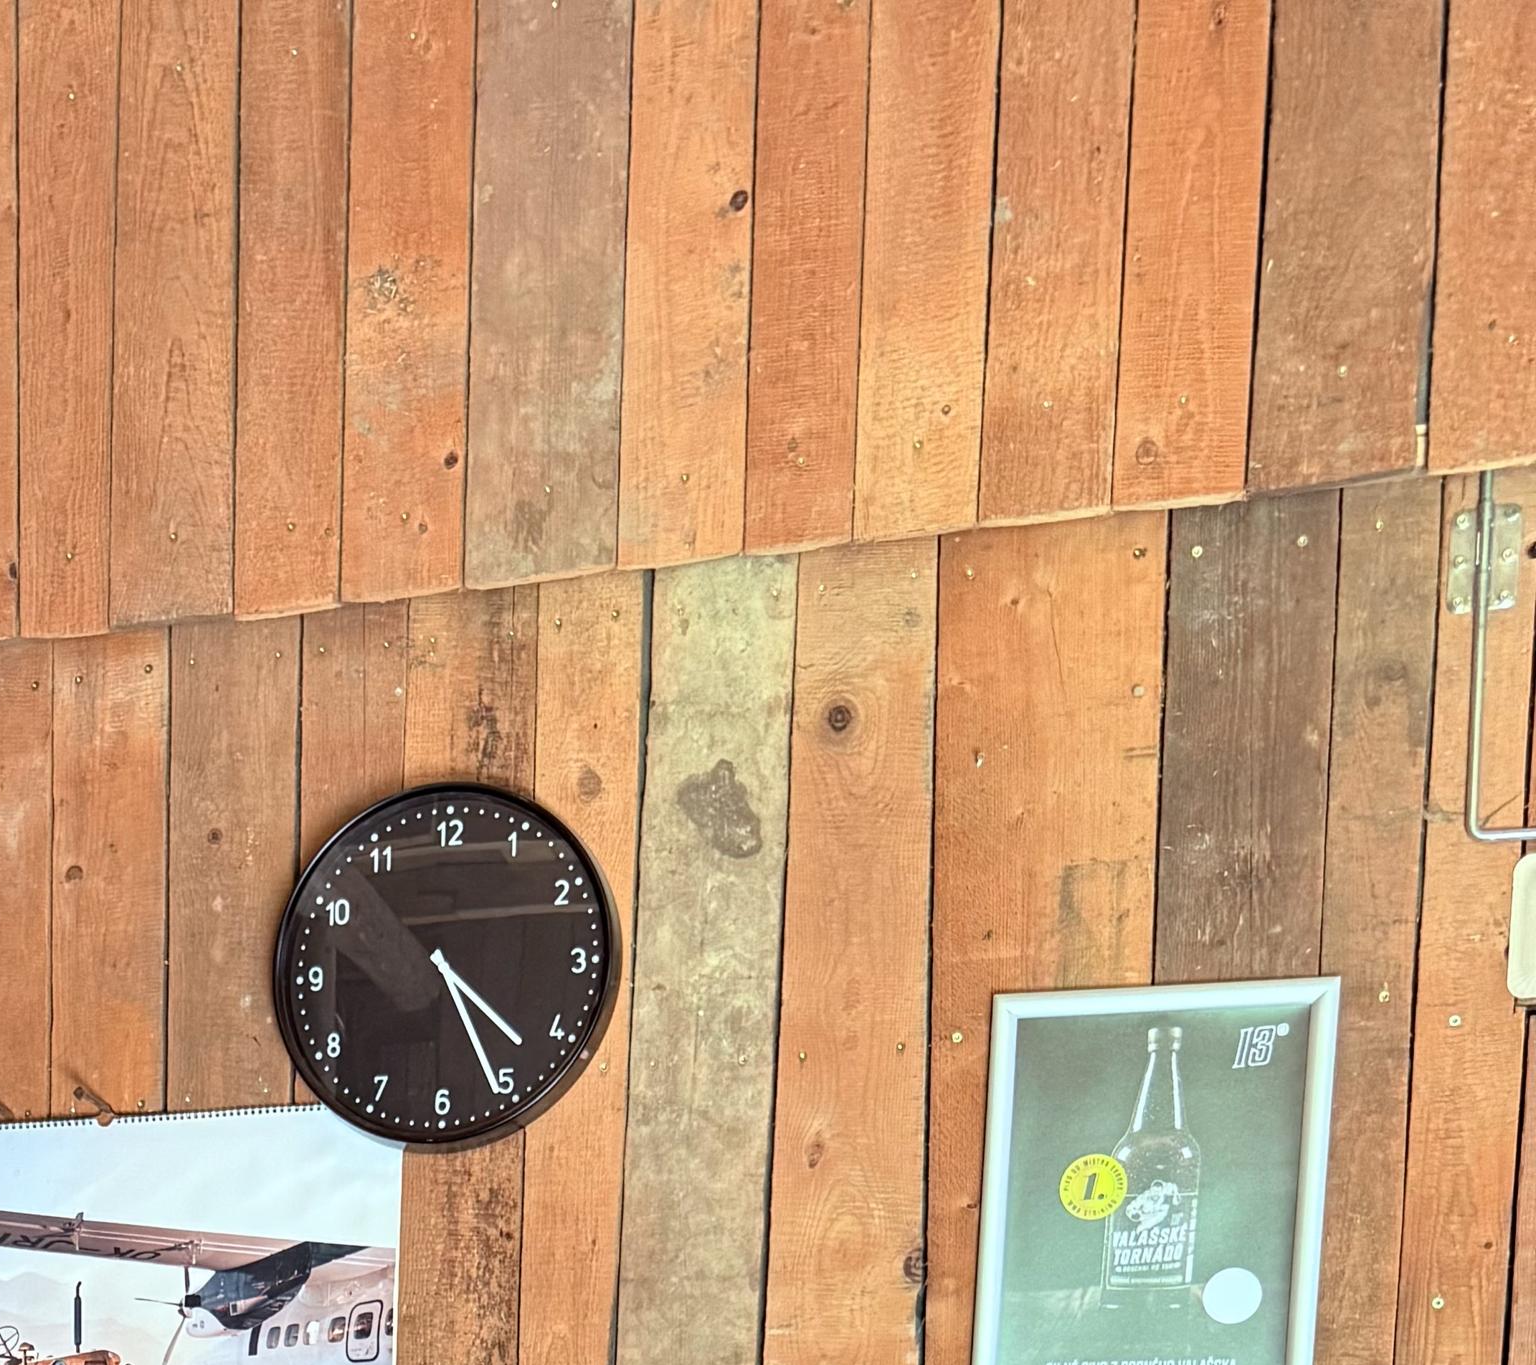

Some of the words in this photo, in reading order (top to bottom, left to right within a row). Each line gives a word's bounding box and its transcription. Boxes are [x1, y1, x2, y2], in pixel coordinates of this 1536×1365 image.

[437, 820, 463, 847] 12
[507, 832, 517, 858] 1
[370, 847, 392, 873] 11
[554, 880, 569, 906] 2
[326, 899, 350, 926] 10
[570, 948, 587, 974] 3
[308, 966, 323, 992] 9
[549, 1014, 565, 1040] 4
[327, 1033, 341, 1058] 8
[373, 1075, 389, 1101] 7
[498, 1068, 514, 1094] 5
[434, 1089, 451, 1115] 6
